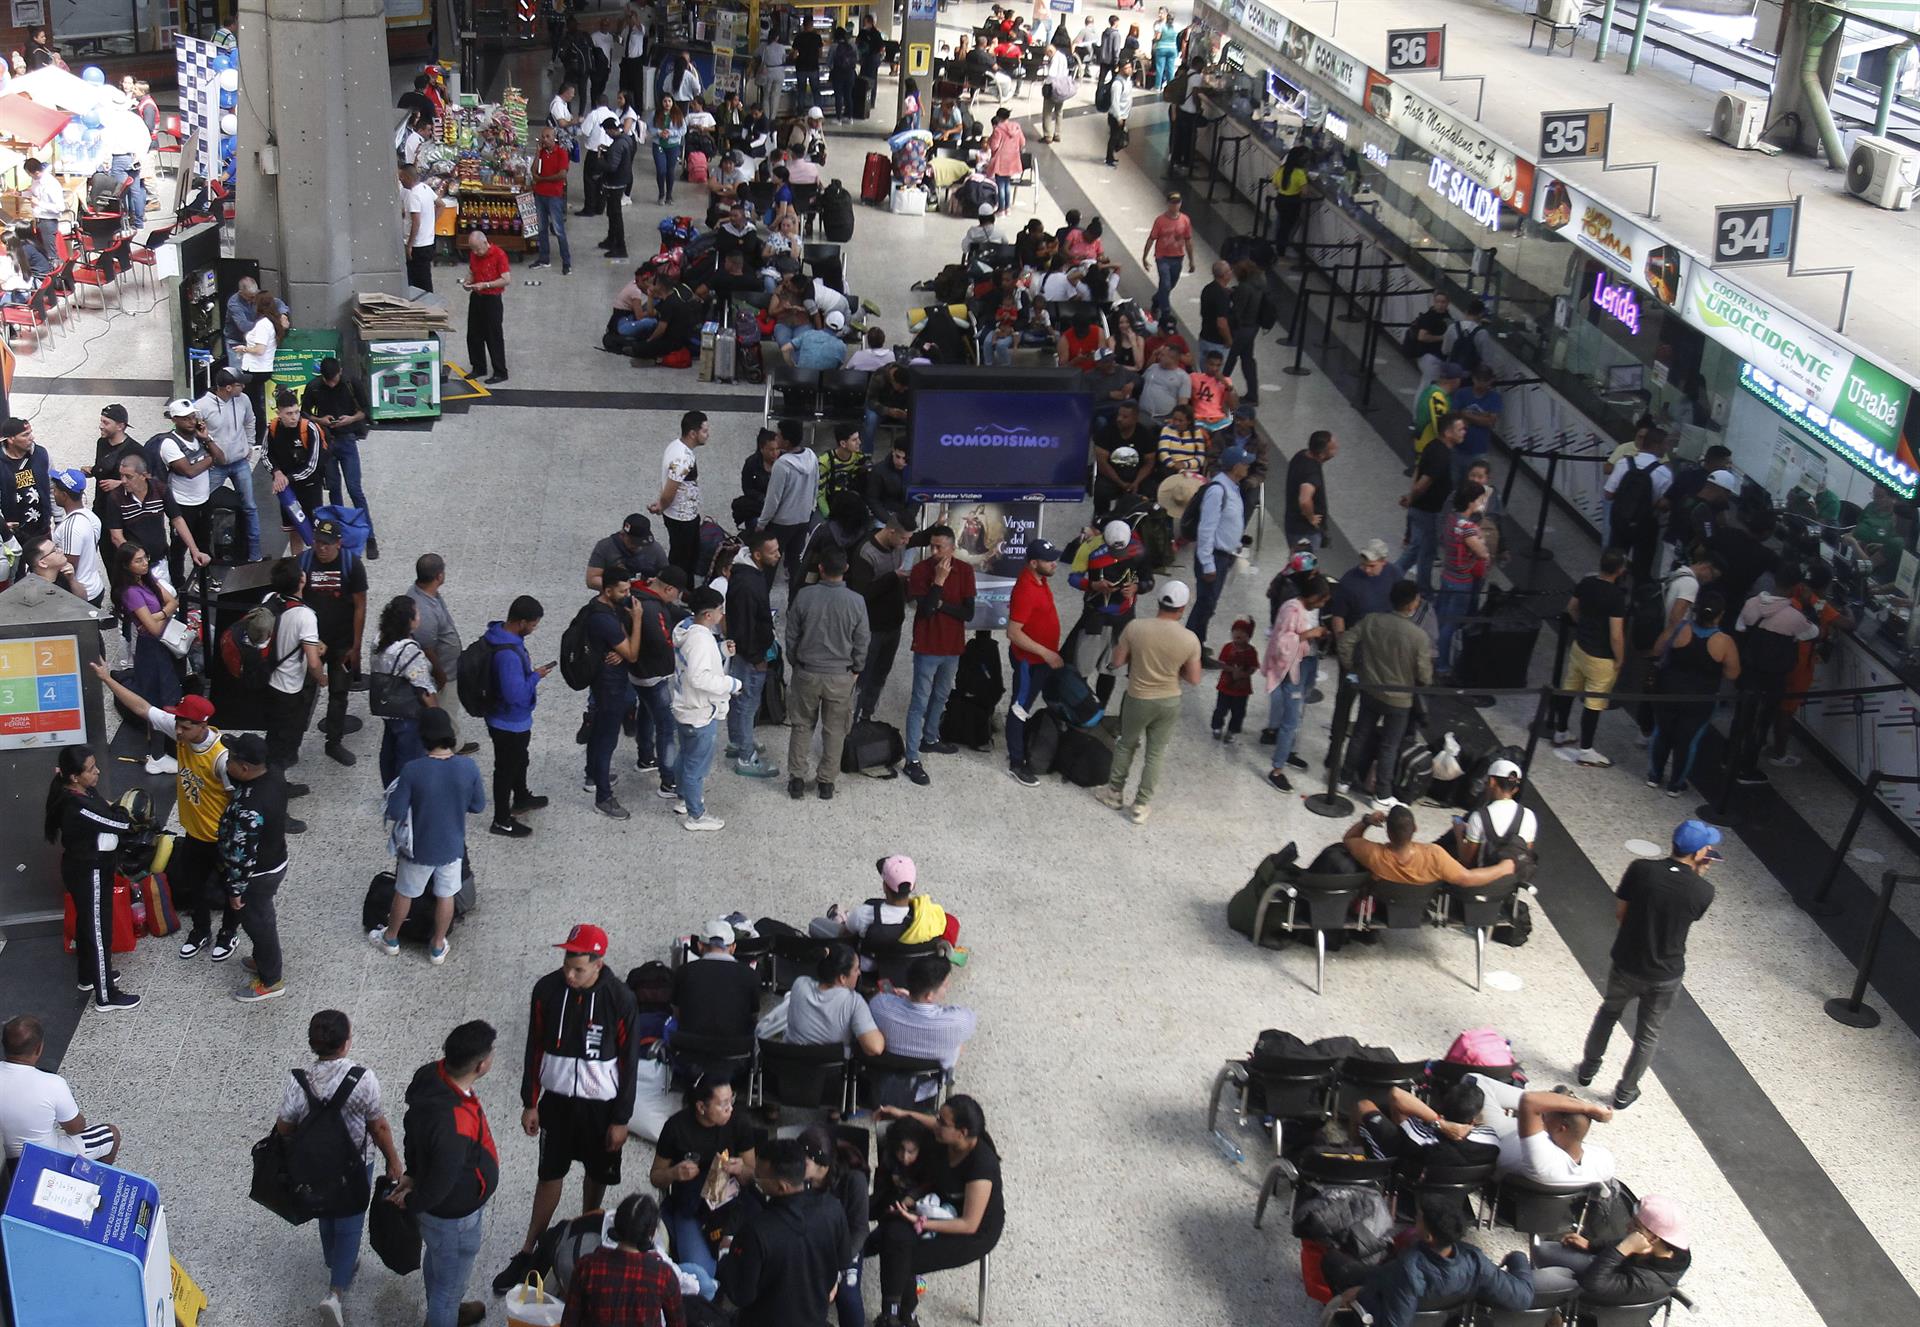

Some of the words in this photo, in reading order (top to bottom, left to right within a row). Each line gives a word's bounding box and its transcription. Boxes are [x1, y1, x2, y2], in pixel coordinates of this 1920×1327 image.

[1391, 37, 1426, 65] 36
[1403, 94, 1424, 125] Flota
[1425, 107, 1473, 155] Magdalena
[1474, 140, 1497, 170] S.A.
[1544, 120, 1586, 154] 35
[1428, 158, 1450, 195] DE
[1449, 171, 1501, 232] SALIDA
[1719, 215, 1769, 256] 34
[1712, 281, 1770, 322] COOTRANS
[1706, 293, 1834, 382] UROCCIDENTE
[1196, 381, 1215, 401] LA
[1848, 374, 1899, 428] Urabá
[940, 434, 1060, 448] COMODISIMOS
[1003, 515, 1035, 532] Virgen
[1010, 533, 1025, 545] del
[1, 655, 11, 669] 1
[41, 651, 54, 666] 2
[3, 690, 15, 704] 3
[44, 687, 57, 701] 4
